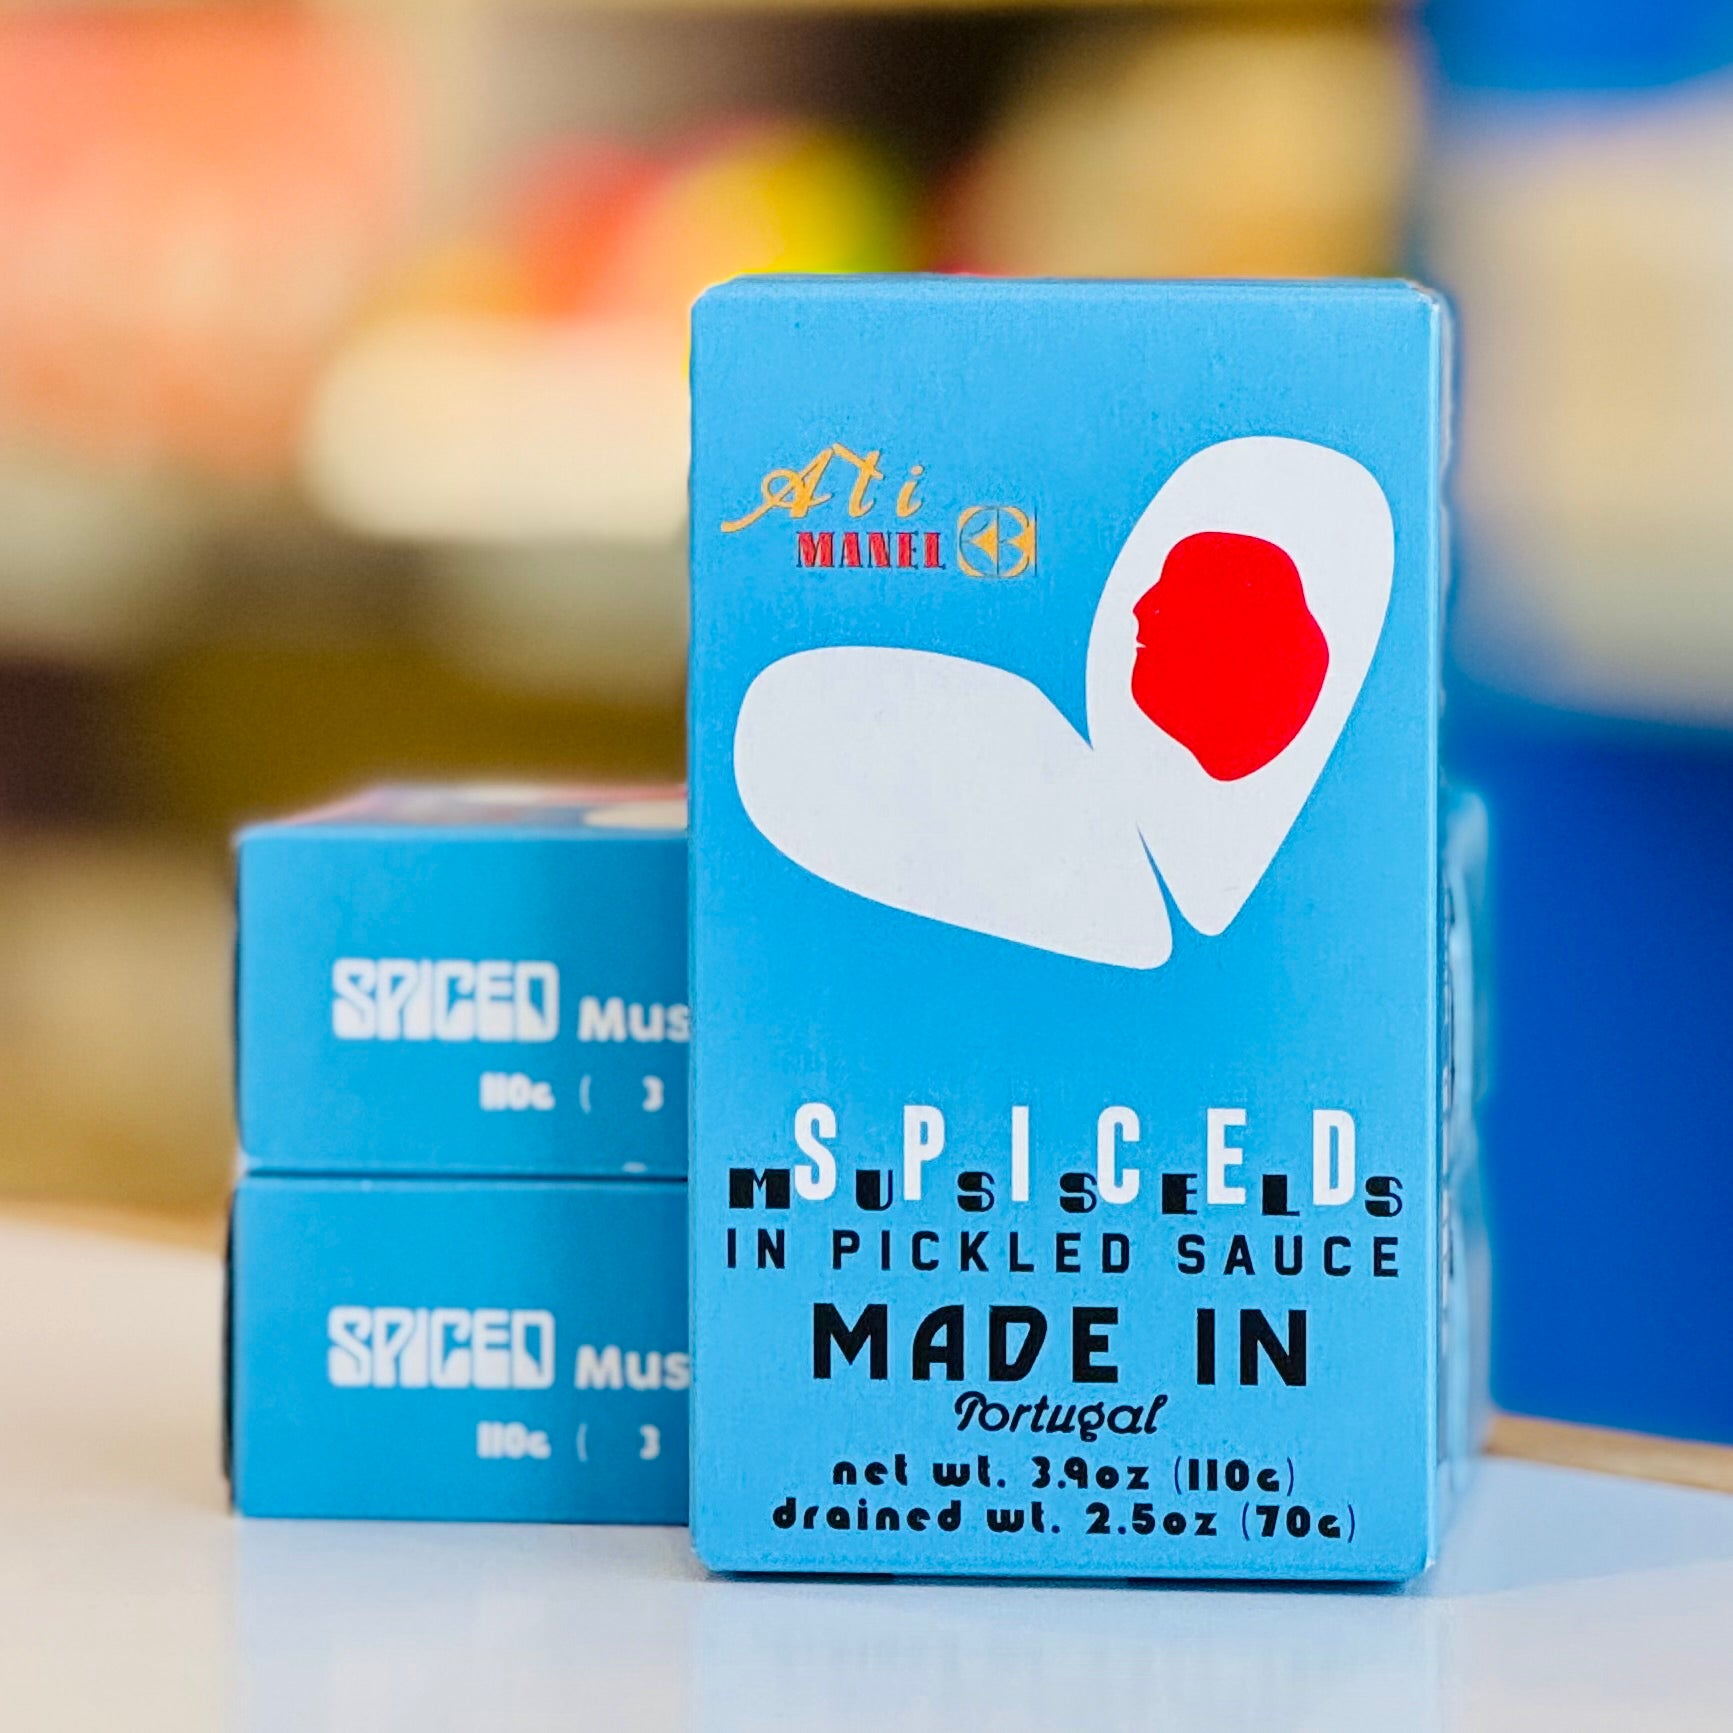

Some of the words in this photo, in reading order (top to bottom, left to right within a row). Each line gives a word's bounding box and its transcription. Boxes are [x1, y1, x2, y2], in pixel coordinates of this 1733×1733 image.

[796, 530, 946, 570] MANEL
[332, 957, 559, 1042] SPICED
[794, 1102, 1356, 1206] SPICED
[728, 1167, 1403, 1217] MUSSELS
[727, 1228, 785, 1269] IN
[832, 1229, 1130, 1274] PICKLED
[1177, 1233, 1399, 1277] SAUCE
[328, 1305, 555, 1389] SPICED
[813, 1302, 1119, 1384] MADE
[1196, 1308, 1307, 1387] IN
[954, 1390, 1168, 1442] Portugal
[832, 1453, 908, 1487] net
[932, 1455, 1006, 1488] wt.
[1031, 1455, 1149, 1490] 3.9oz
[772, 1497, 962, 1532] drained
[986, 1501, 1060, 1534] wt.
[1086, 1501, 1217, 1537] 2.5oz
